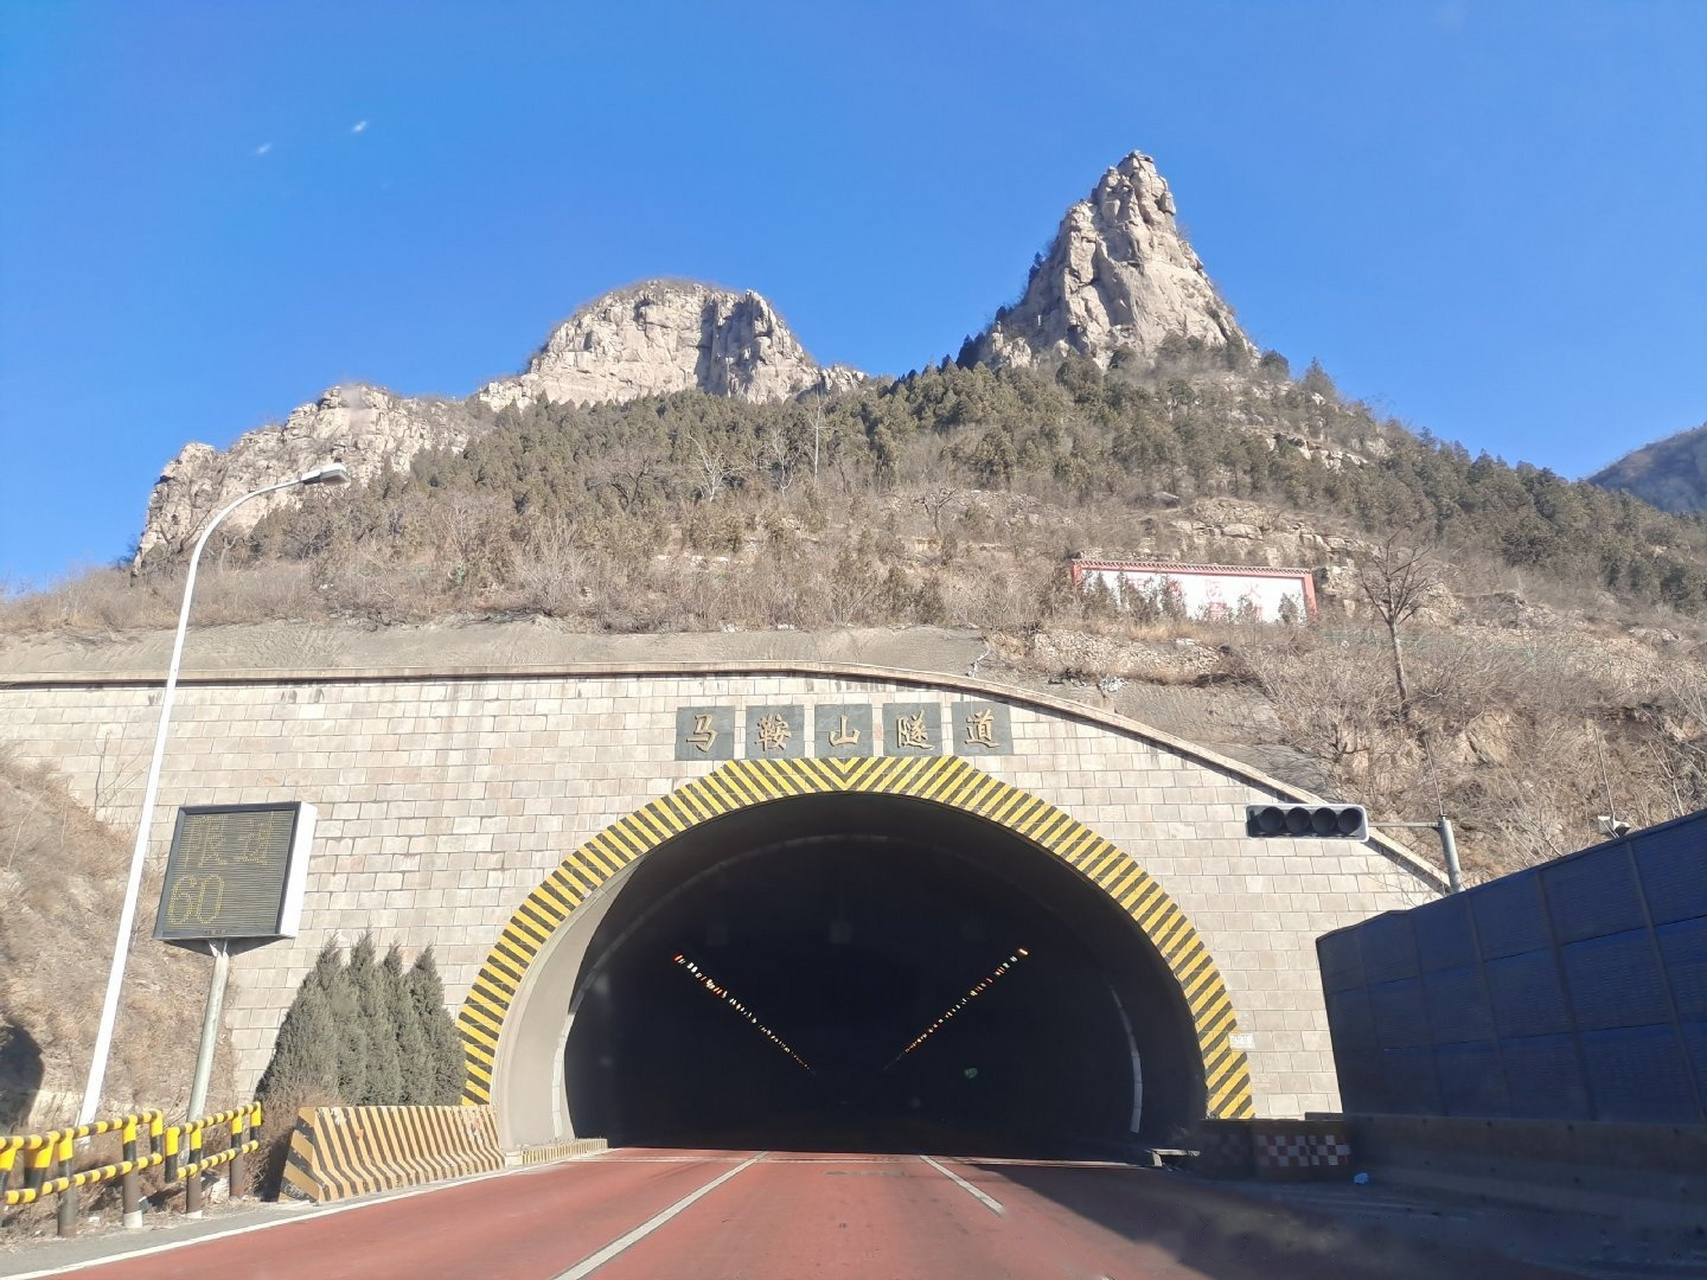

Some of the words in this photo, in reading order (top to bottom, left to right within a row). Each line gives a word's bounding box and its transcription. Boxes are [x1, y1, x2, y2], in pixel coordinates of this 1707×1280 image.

[686, 709, 999, 752] 马鞍山隧道
[168, 873, 225, 925] 60
